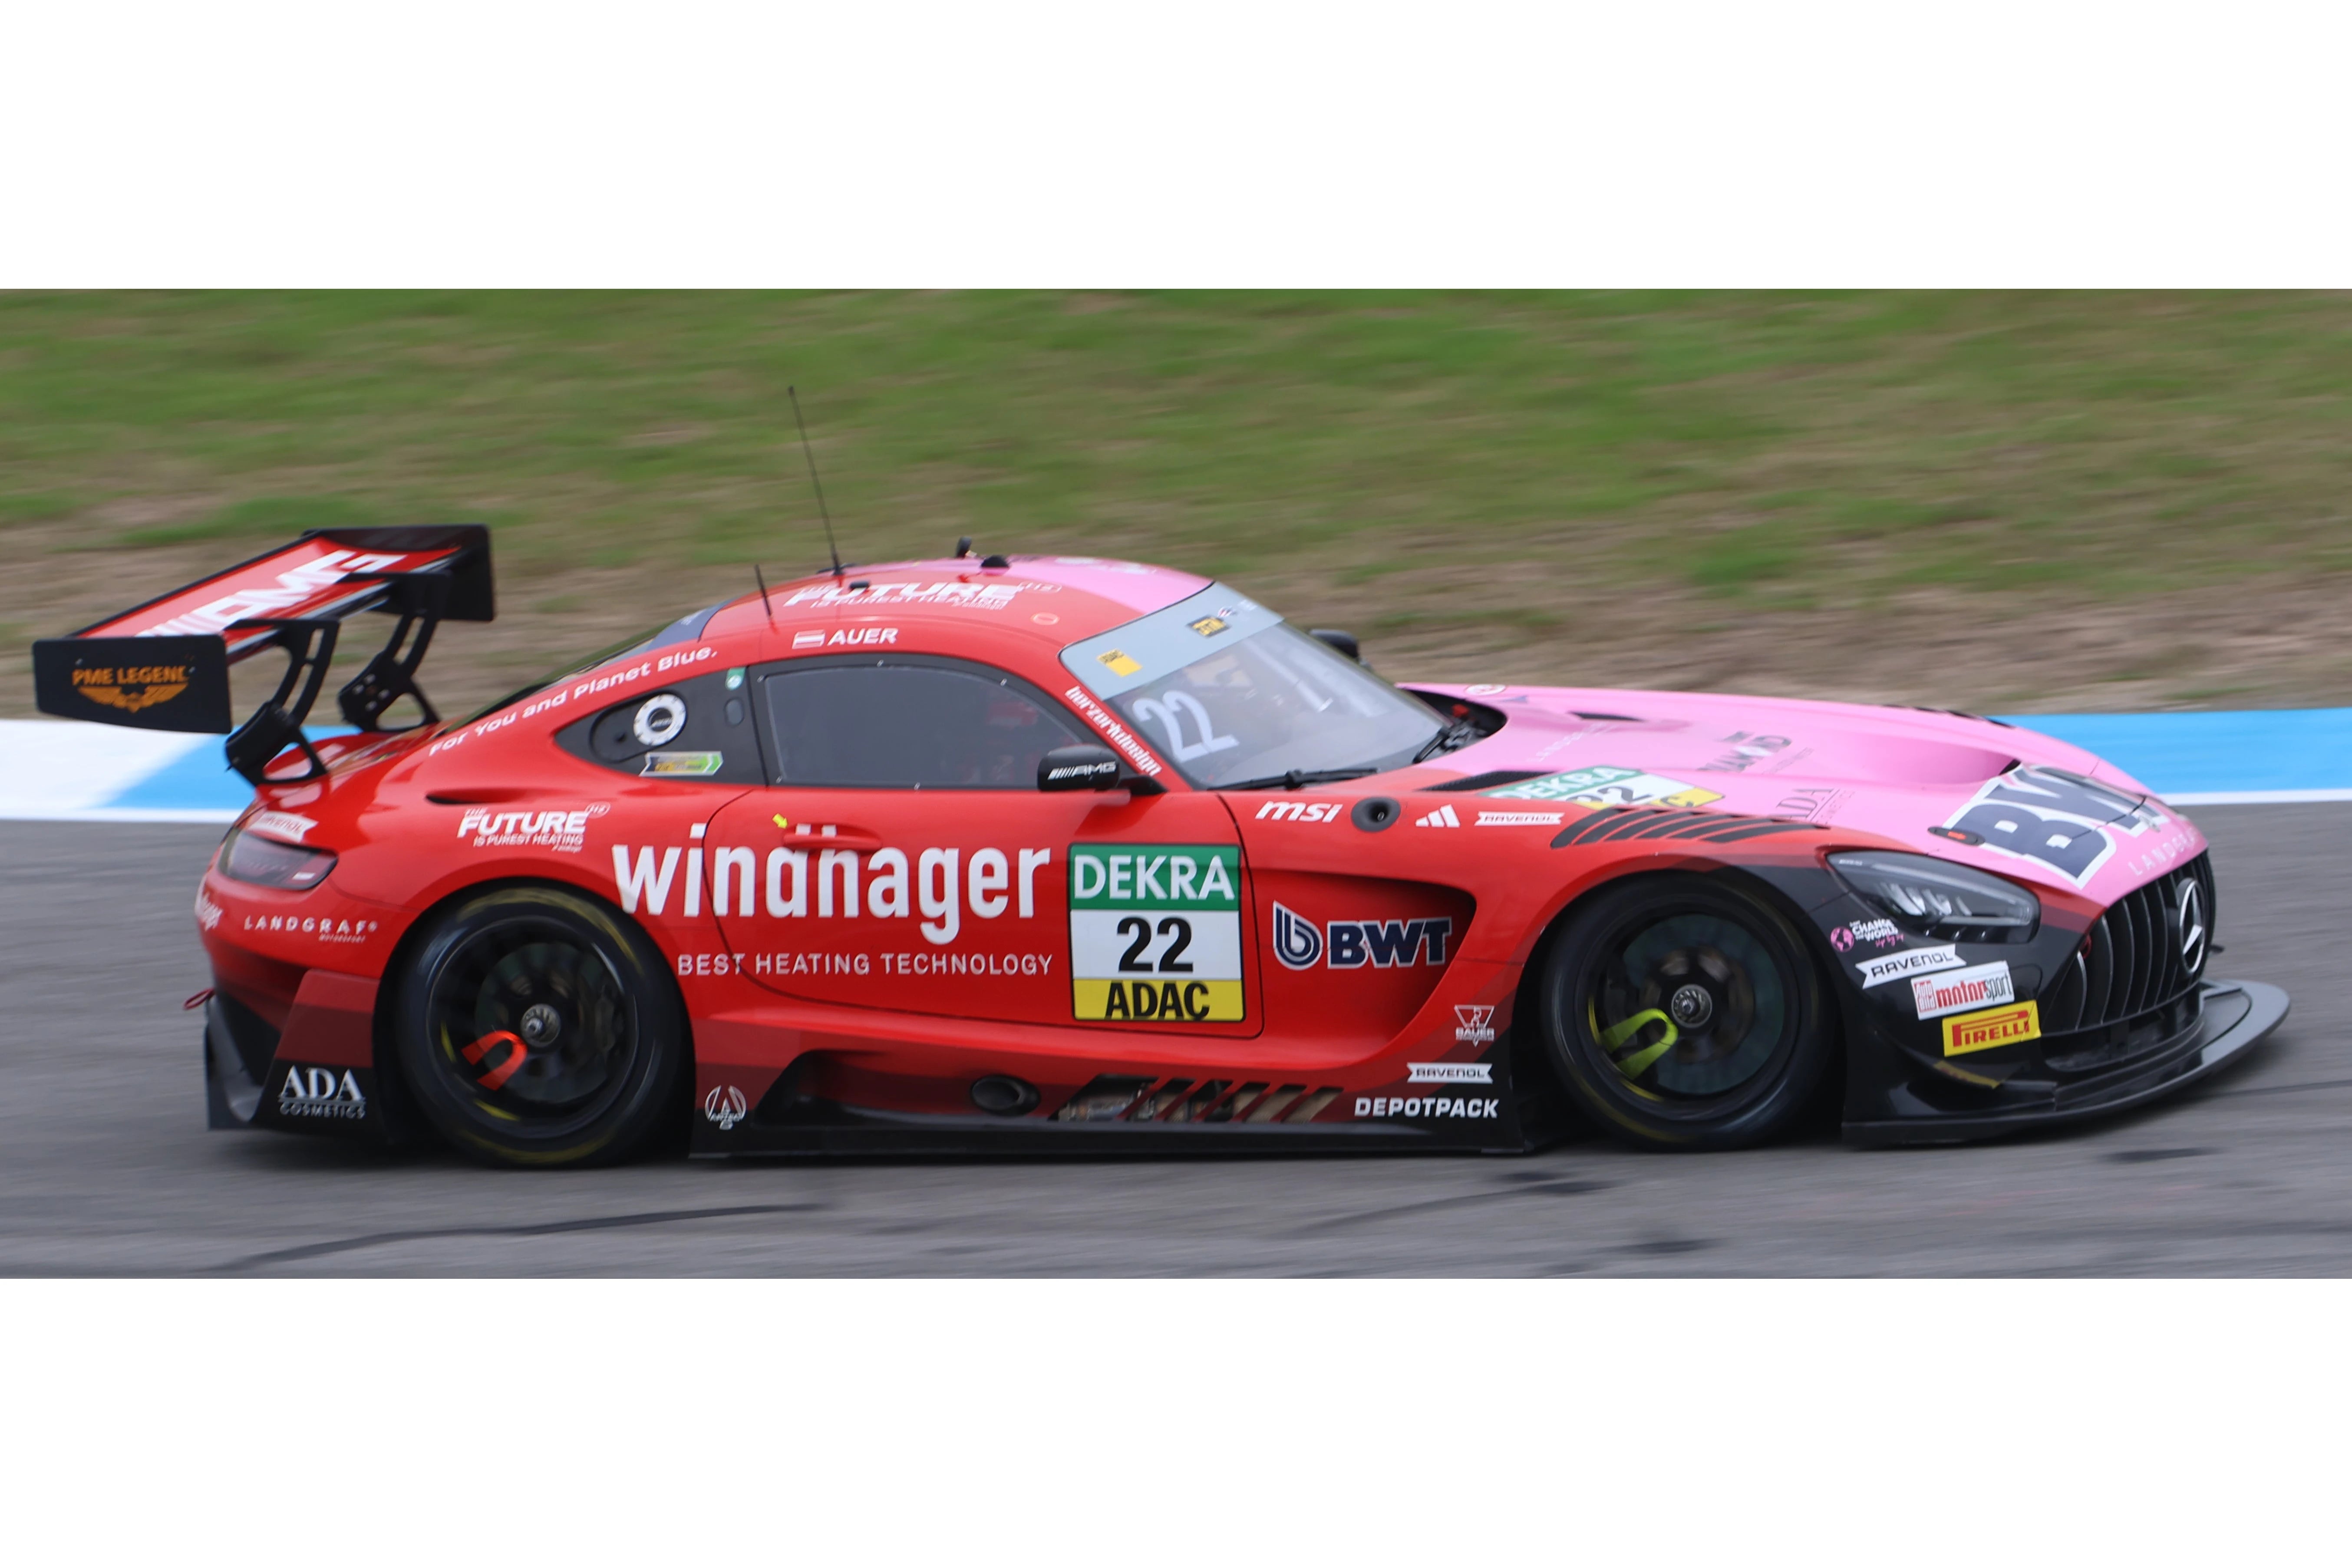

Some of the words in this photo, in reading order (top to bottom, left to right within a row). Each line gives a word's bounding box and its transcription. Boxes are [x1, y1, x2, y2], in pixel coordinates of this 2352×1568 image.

[782, 581, 1018, 607] FUTURE
[827, 628, 898, 646] AUER
[71, 667, 114, 686] PME
[429, 734, 468, 756] For
[475, 711, 518, 737] You
[522, 689, 568, 719] and
[573, 662, 652, 700] Planet
[656, 647, 718, 673] Blue.
[1132, 689, 1240, 763] 22
[456, 811, 587, 838] FUTURE
[1255, 800, 1343, 823] msi
[1074, 853, 1235, 901] DEKRA
[1116, 916, 1194, 974] 22
[1327, 917, 1453, 970] BWT
[677, 953, 746, 976] BEST
[755, 953, 870, 976] HEATING
[880, 953, 1053, 976] TECHNOLOGY
[1871, 951, 1954, 978] RAVENOL
[1104, 981, 1210, 1020] ADAC
[1936, 972, 2012, 1009] motorsport
[1455, 1027, 1494, 1037] BAUER
[1951, 1009, 2031, 1048] PIRELLI
[280, 1064, 363, 1101] ADA
[1415, 1067, 1485, 1078] RAVENOL
[280, 1101, 366, 1119] COSMETICS
[1354, 1096, 1500, 1119] DEPOTPACK
